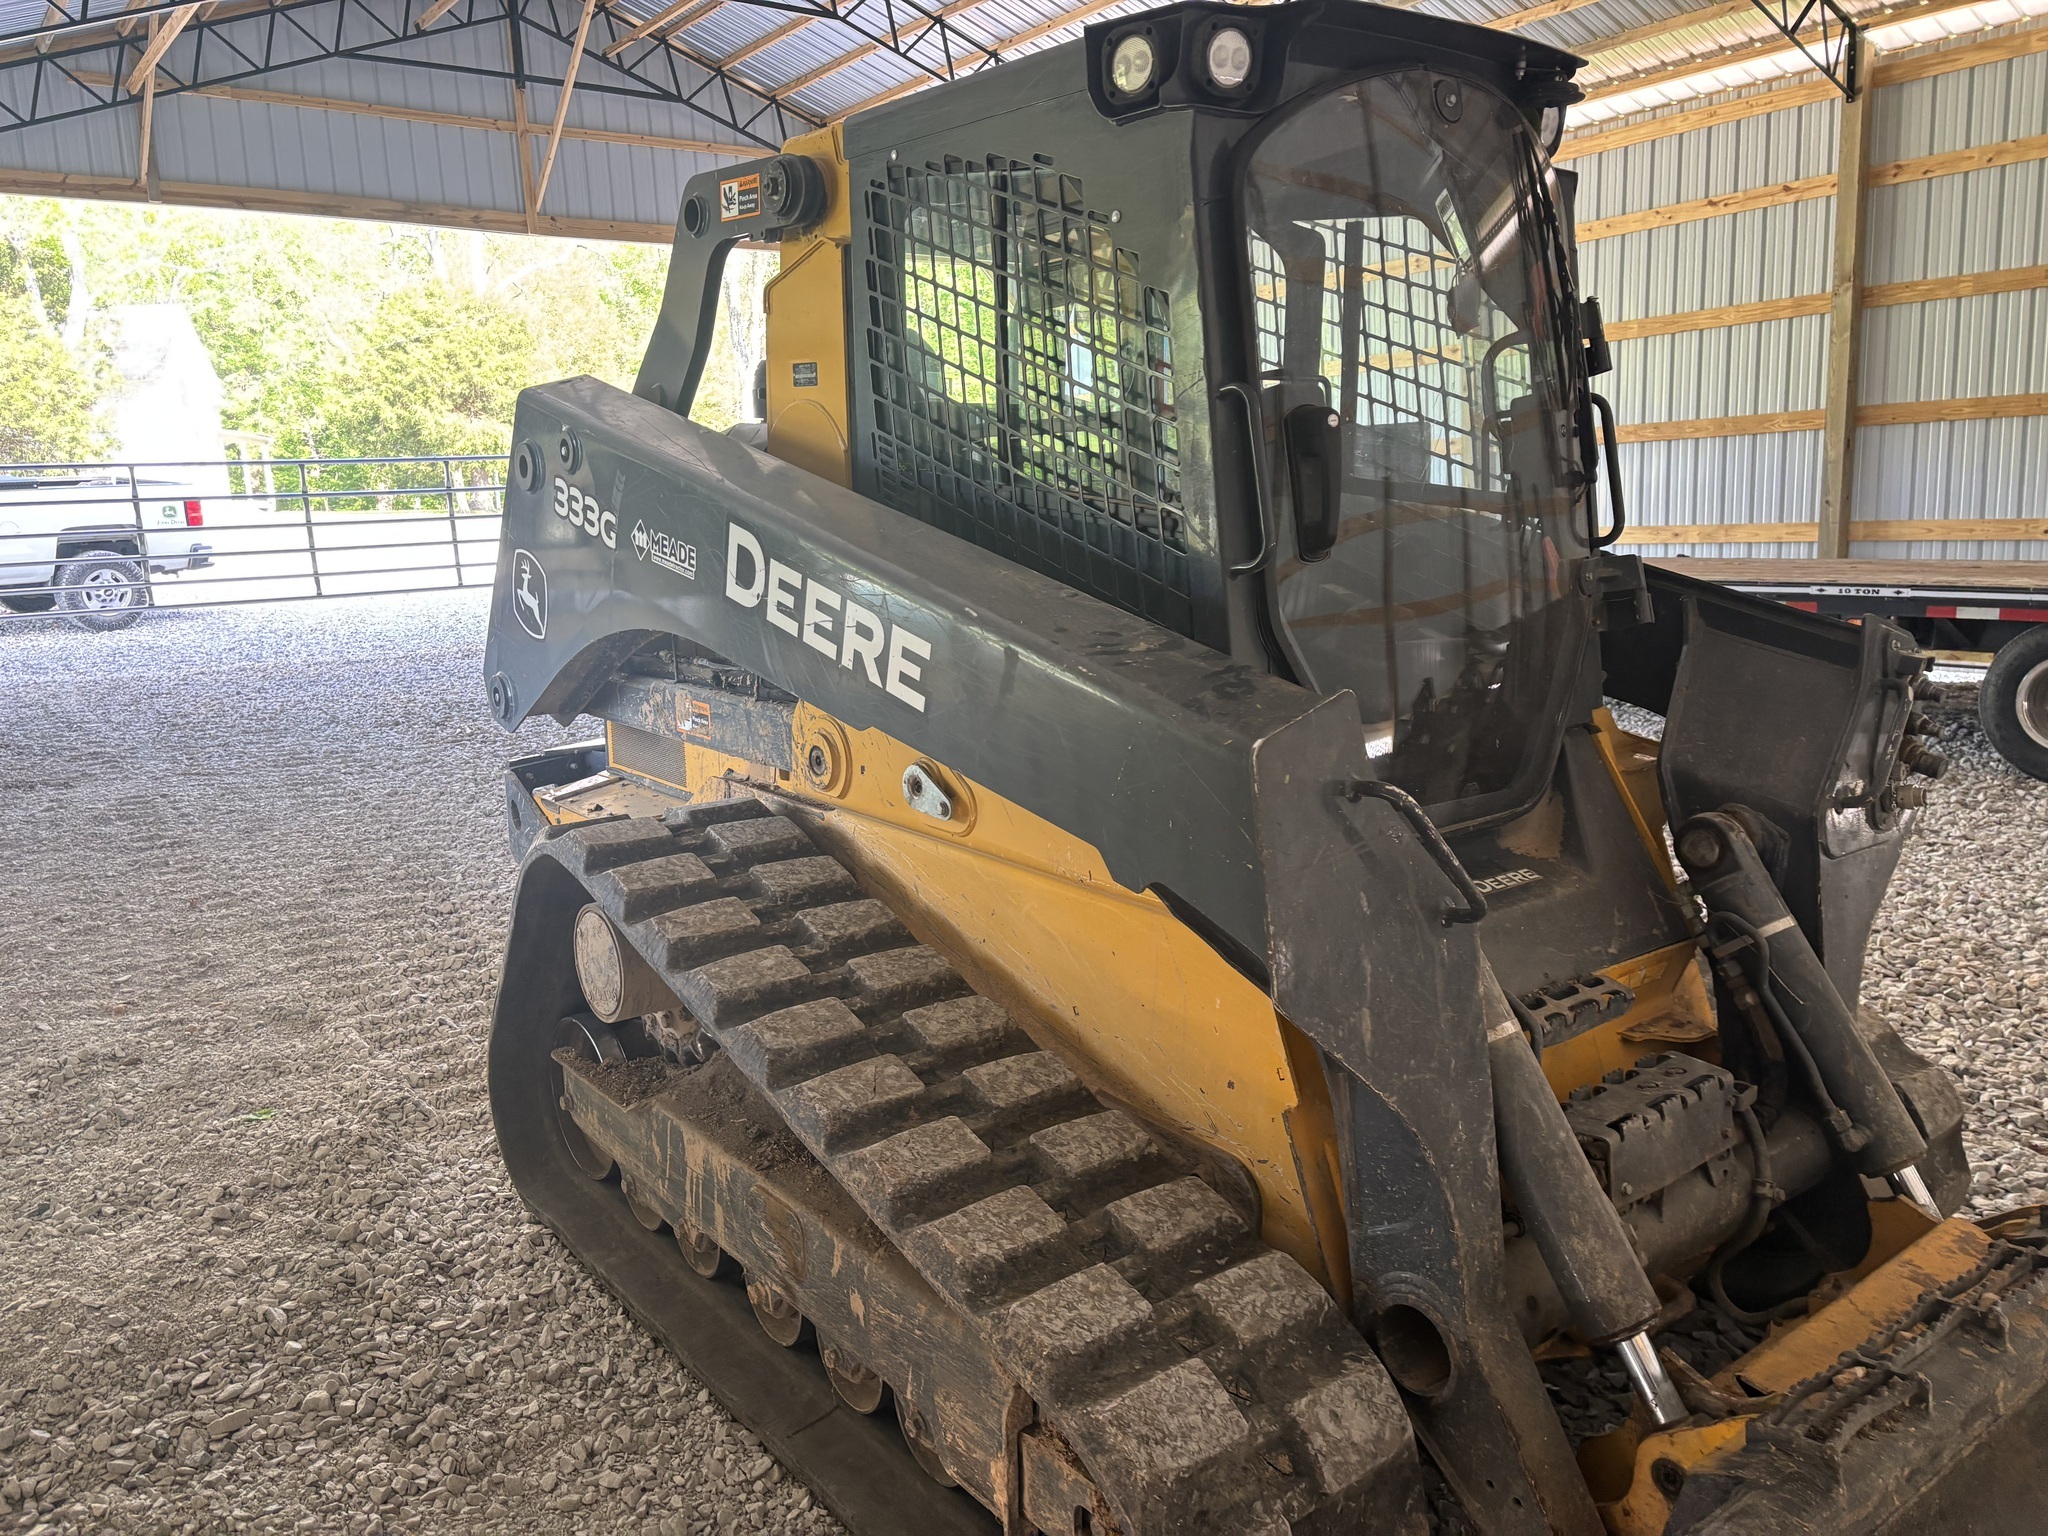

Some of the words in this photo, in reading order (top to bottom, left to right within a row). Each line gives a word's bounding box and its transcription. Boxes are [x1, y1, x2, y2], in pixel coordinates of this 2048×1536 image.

[554, 477, 617, 549] 333G
[650, 529, 696, 571] MEADE
[725, 521, 932, 713] DEERE
[1472, 868, 1541, 894] DEERE
